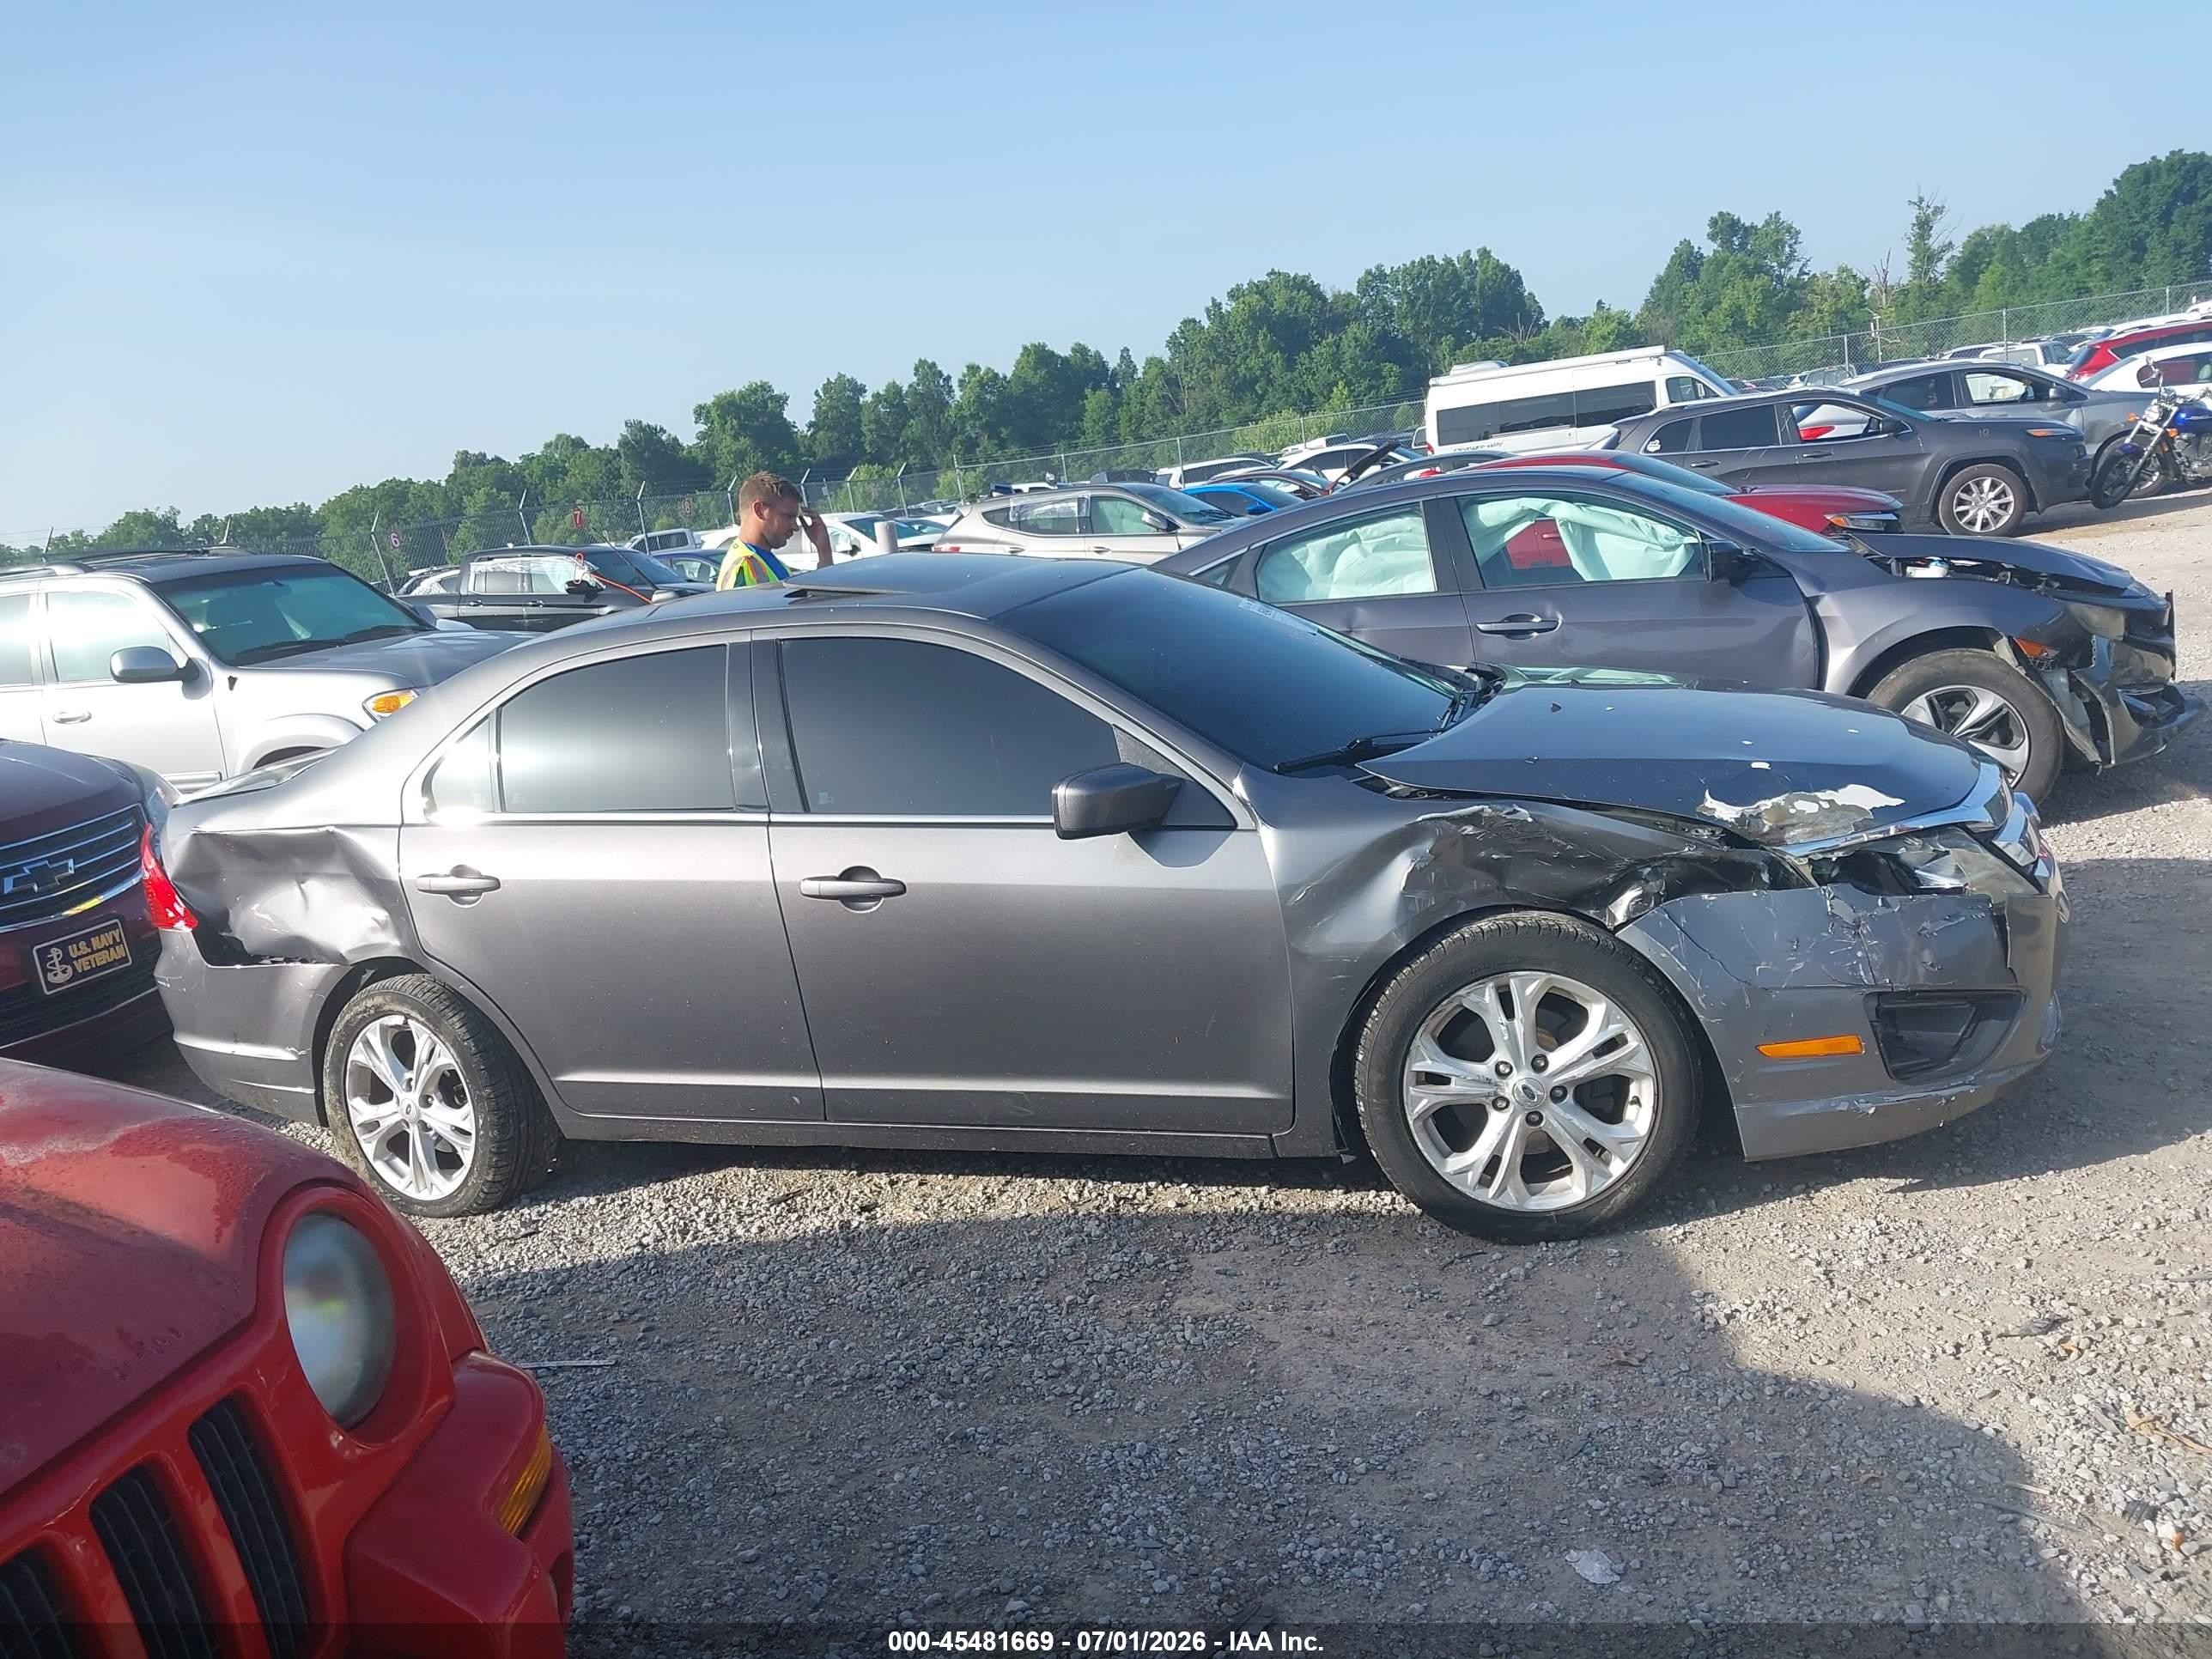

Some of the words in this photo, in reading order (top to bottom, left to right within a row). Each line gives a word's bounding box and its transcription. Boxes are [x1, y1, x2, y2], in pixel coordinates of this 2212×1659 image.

[684, 501, 690, 514] 8
[574, 511, 580, 524] 7
[390, 532, 400, 548] 6
[69, 941, 91, 958] U.S.
[91, 929, 120, 951] NAVY
[73, 945, 126, 973] VETERAN
